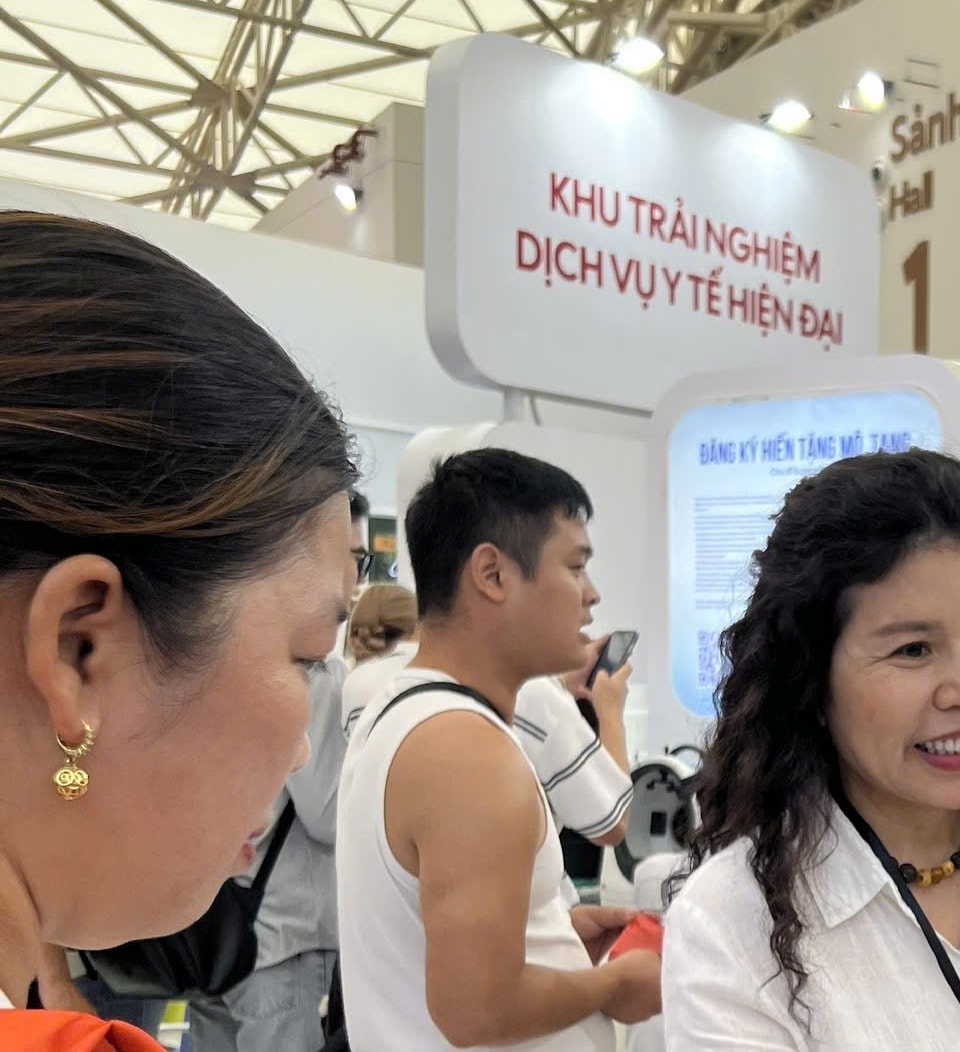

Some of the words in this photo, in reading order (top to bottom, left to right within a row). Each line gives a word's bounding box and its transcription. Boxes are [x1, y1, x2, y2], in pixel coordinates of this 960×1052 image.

[549, 172, 621, 228] KHU
[627, 195, 697, 250] TRẢI
[704, 217, 821, 285] NGHIỆM
[888, 169, 934, 221] Hall
[516, 229, 602, 288] DỊCH
[608, 253, 656, 310] VỤ
[661, 266, 682, 306] Y
[687, 265, 724, 317] TẾ
[728, 282, 793, 337] HIỆN
[799, 302, 843, 351] ĐẠI
[902, 239, 930, 355] 1
[699, 438, 737, 466] ĐĂNG
[738, 434, 760, 465] KÝ
[761, 431, 795, 463] HIẾN
[797, 432, 836, 465] TẶNG
